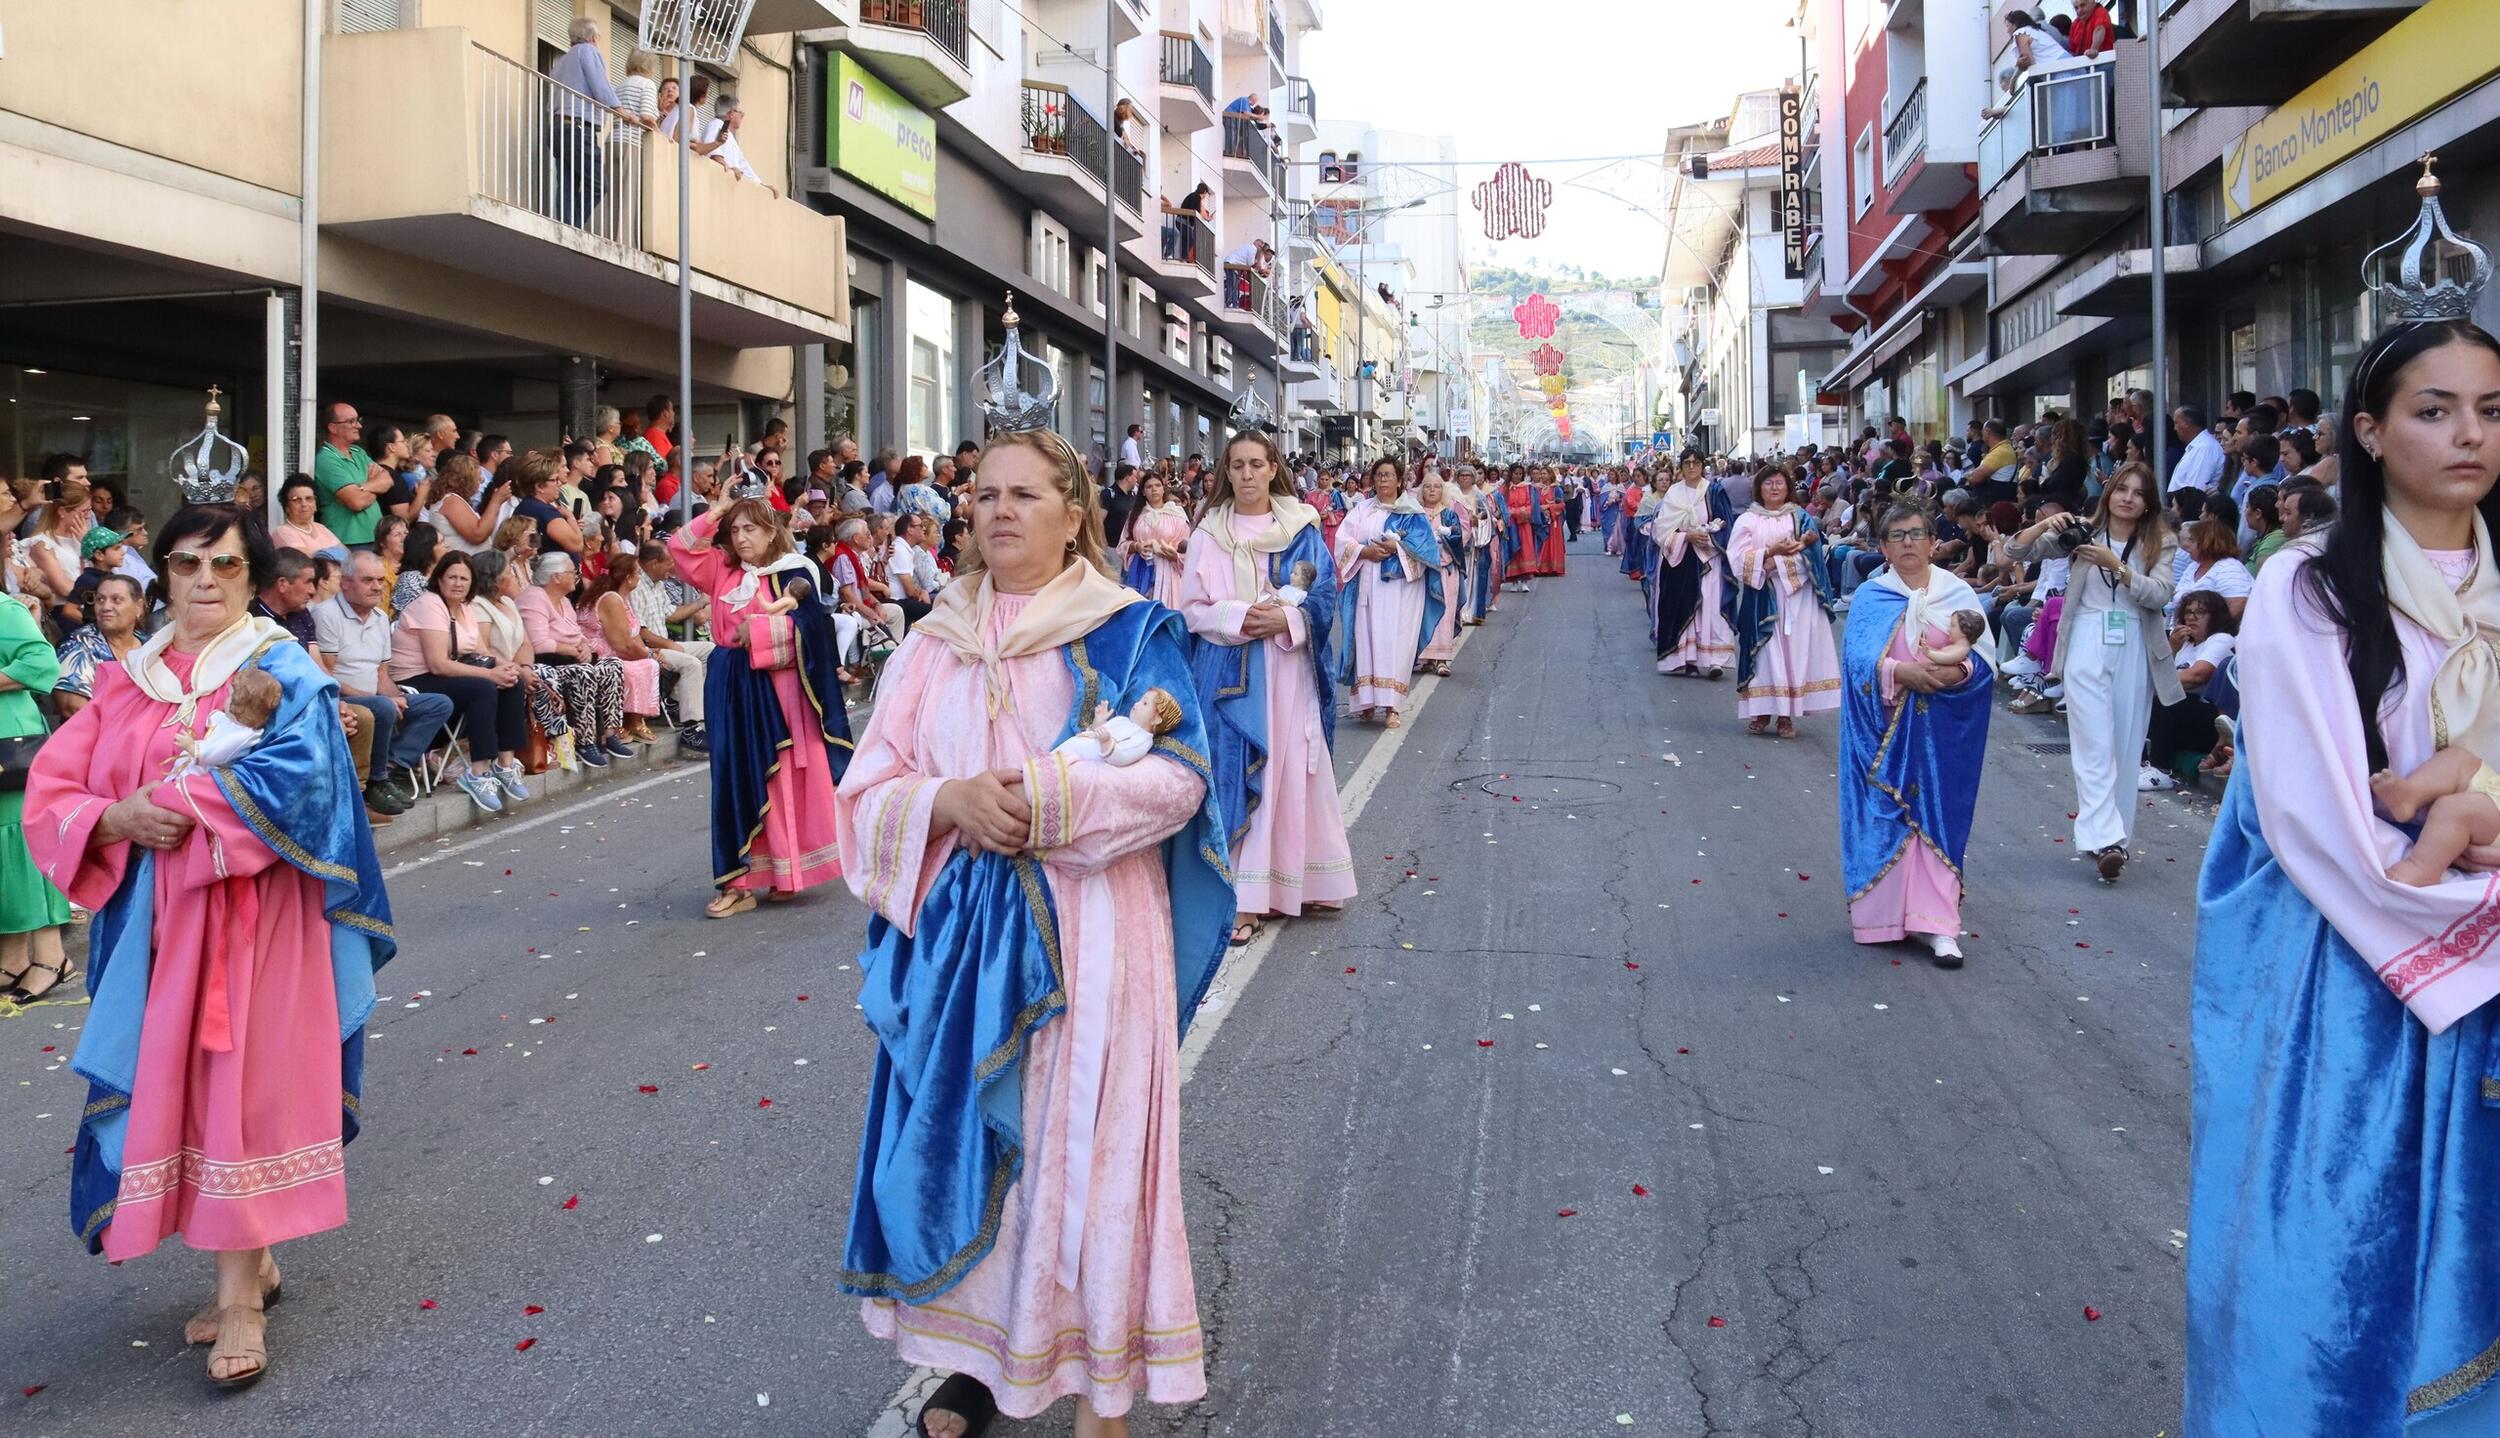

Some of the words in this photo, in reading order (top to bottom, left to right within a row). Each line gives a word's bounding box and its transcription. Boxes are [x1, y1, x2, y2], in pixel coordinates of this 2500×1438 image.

[1783, 99, 1803, 271] COMPRABEM
[2254, 133, 2297, 183] Banco
[2301, 75, 2379, 155] Montepio
[1031, 209, 1234, 392] morais
